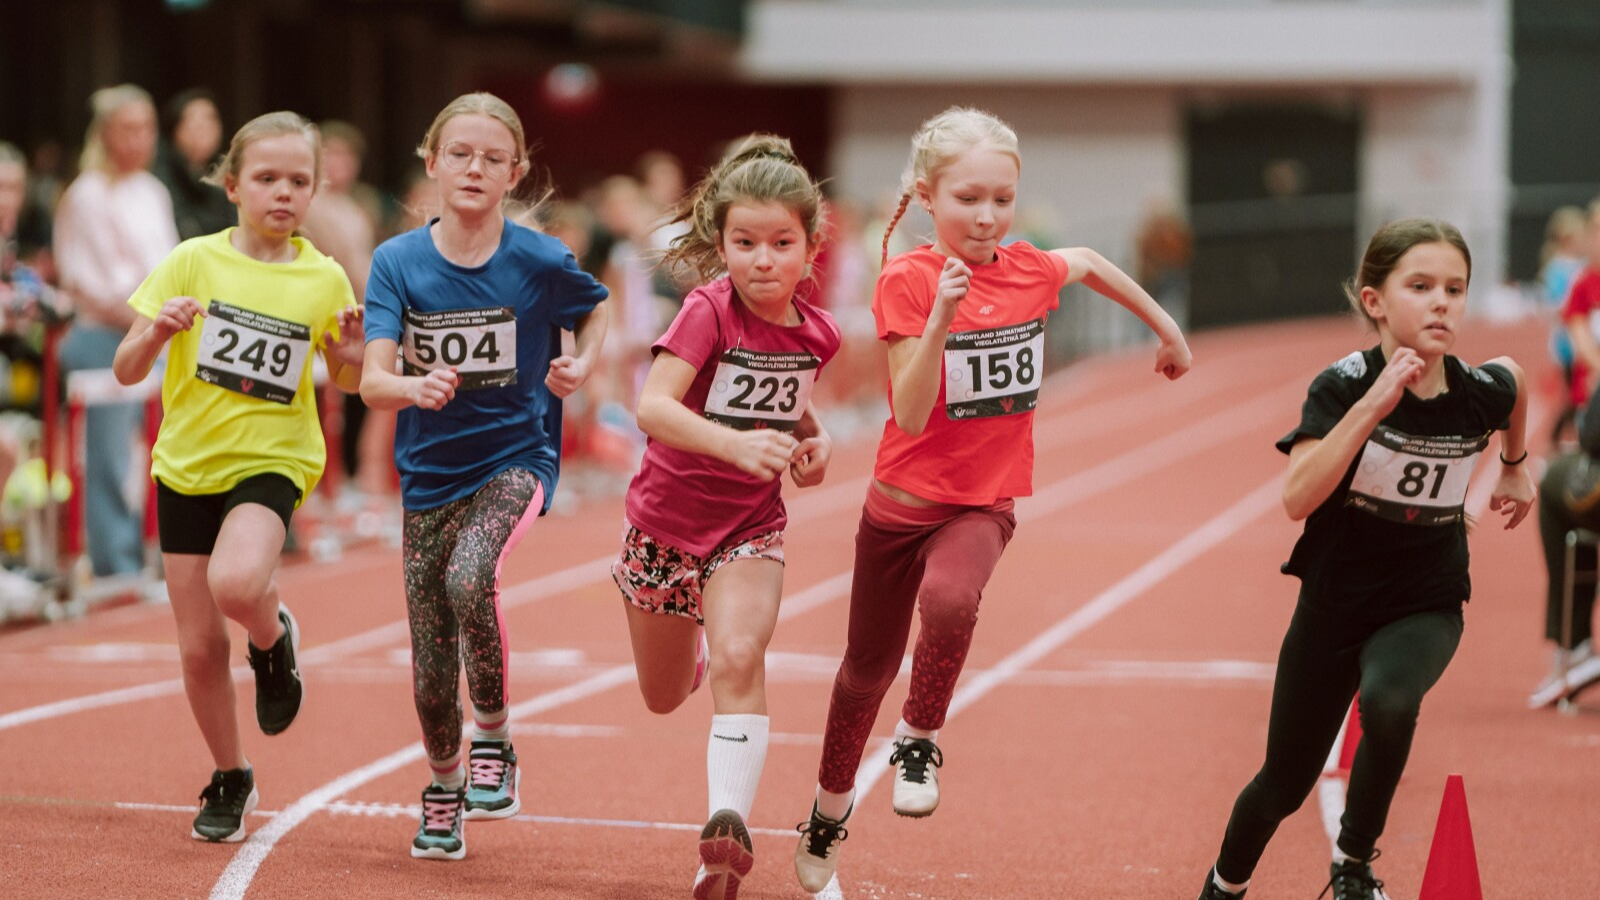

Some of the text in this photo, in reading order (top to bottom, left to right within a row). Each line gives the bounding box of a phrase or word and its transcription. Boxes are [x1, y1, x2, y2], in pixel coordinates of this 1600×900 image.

[444, 310, 480, 319] JAUNATNES
[979, 305, 995, 315] 4F
[955, 331, 995, 342] SPORTLAND
[995, 325, 1027, 337] JAUNATNES
[213, 328, 291, 377] 249
[413, 331, 500, 366] 504
[731, 350, 768, 361] SPORTLAND
[967, 346, 1035, 393] 158
[727, 374, 800, 413] 223
[1384, 431, 1425, 446] SPORTLAND
[1425, 440, 1461, 449] JAUNATNES
[1396, 461, 1449, 499] 81
